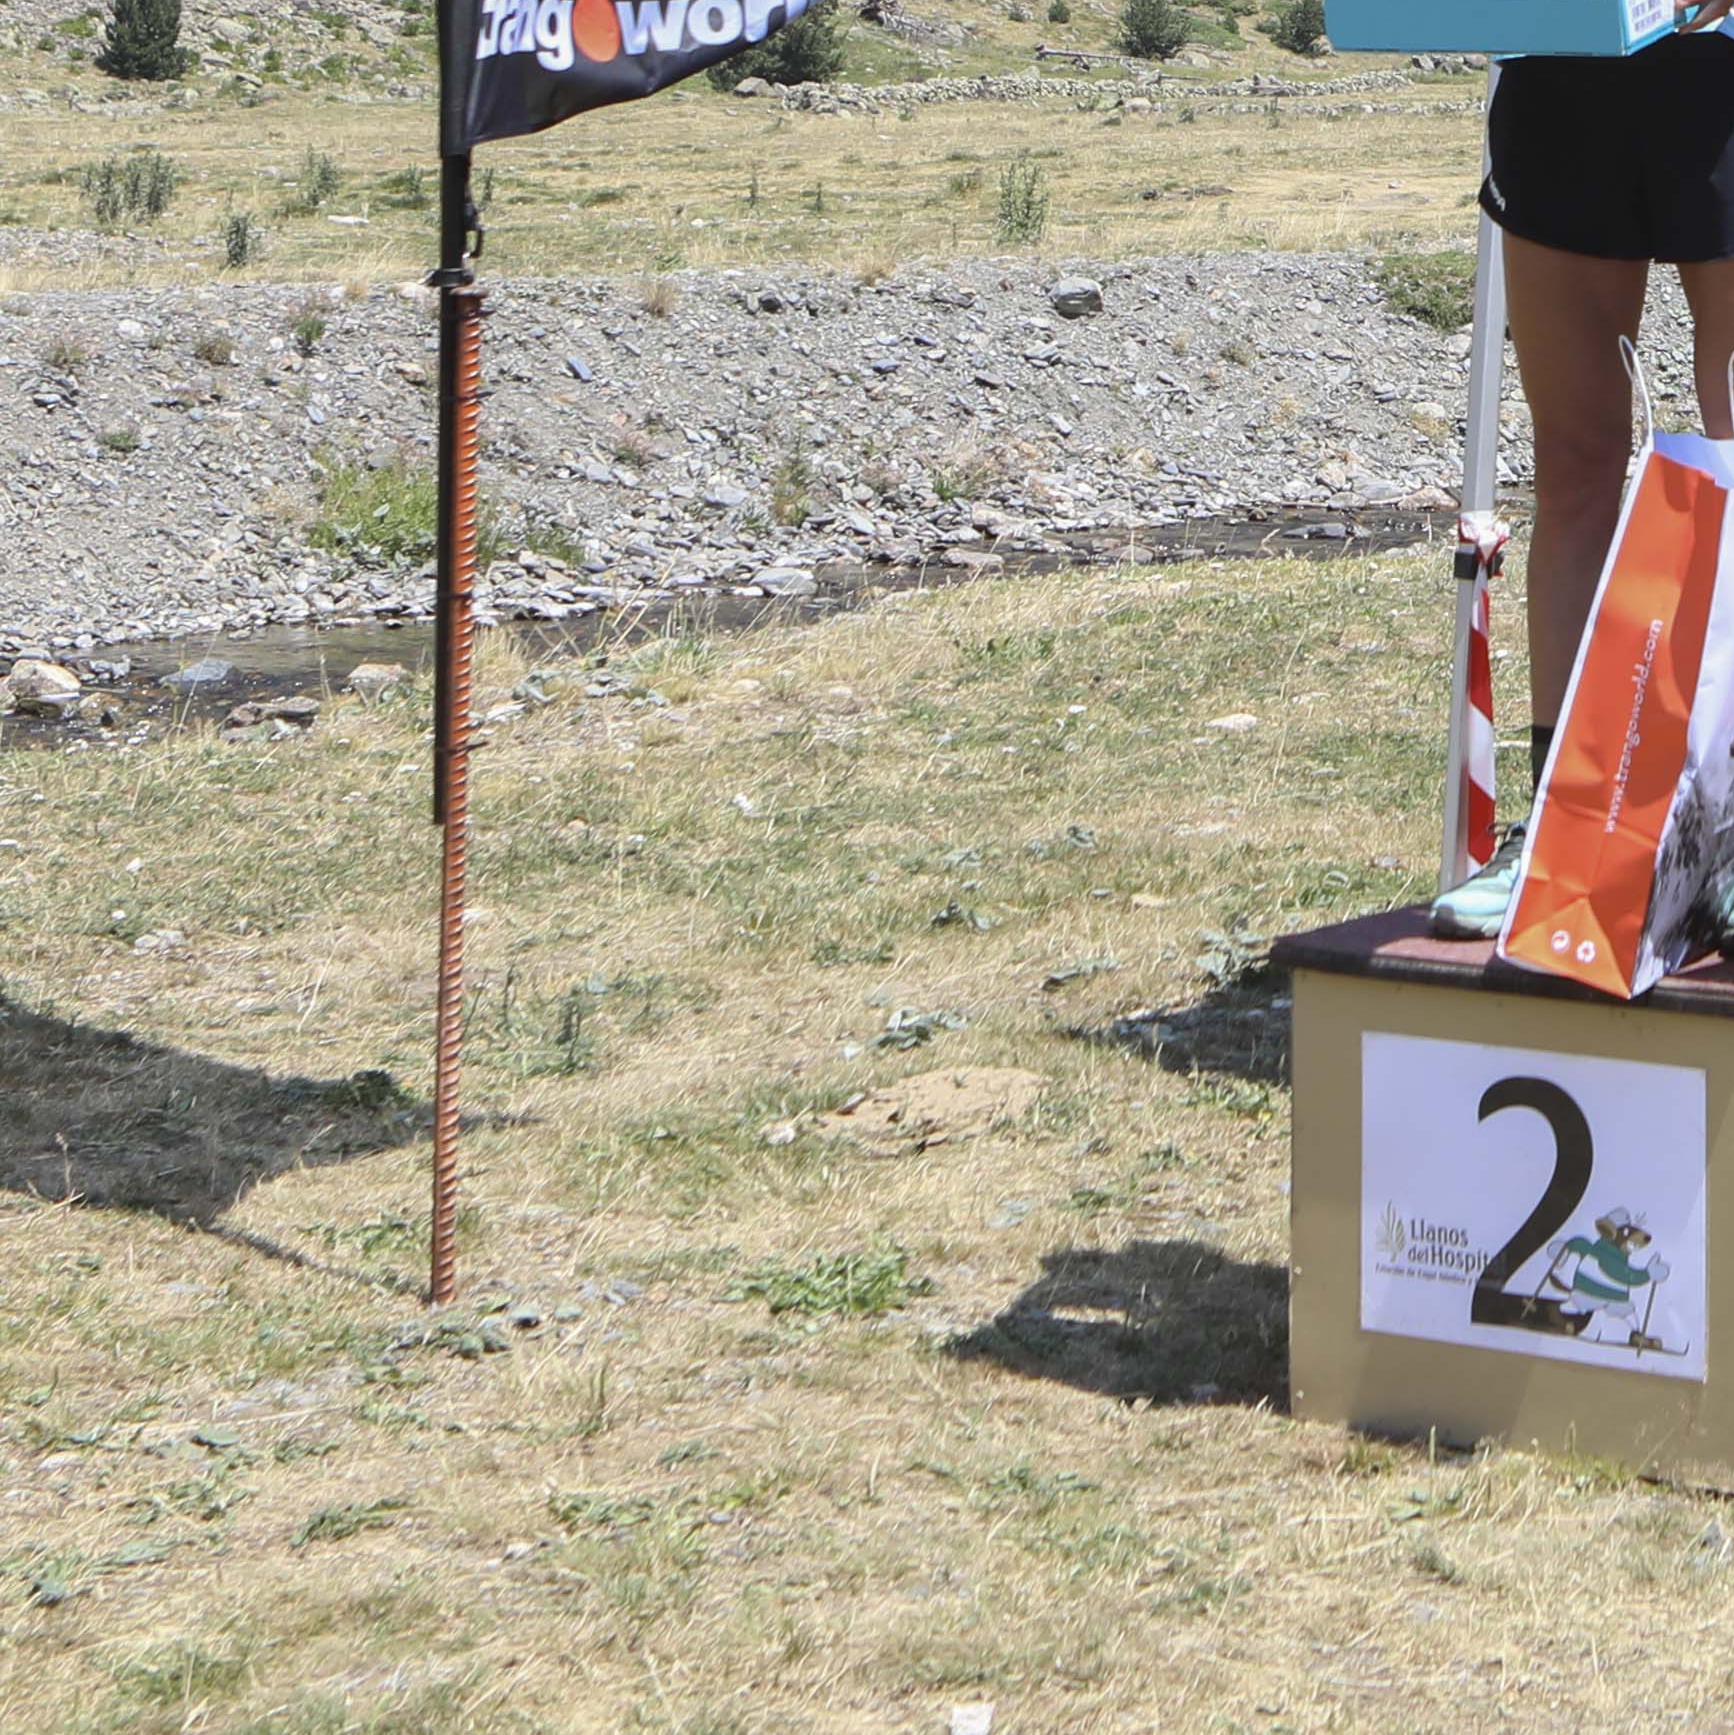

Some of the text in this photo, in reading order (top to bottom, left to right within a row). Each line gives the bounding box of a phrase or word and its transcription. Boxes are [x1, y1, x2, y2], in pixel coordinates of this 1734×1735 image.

[1604, 619, 1664, 834] www.trangoworld.com
[1410, 1218, 1469, 1247] Llanos
[1471, 1076, 1593, 1336] 2
